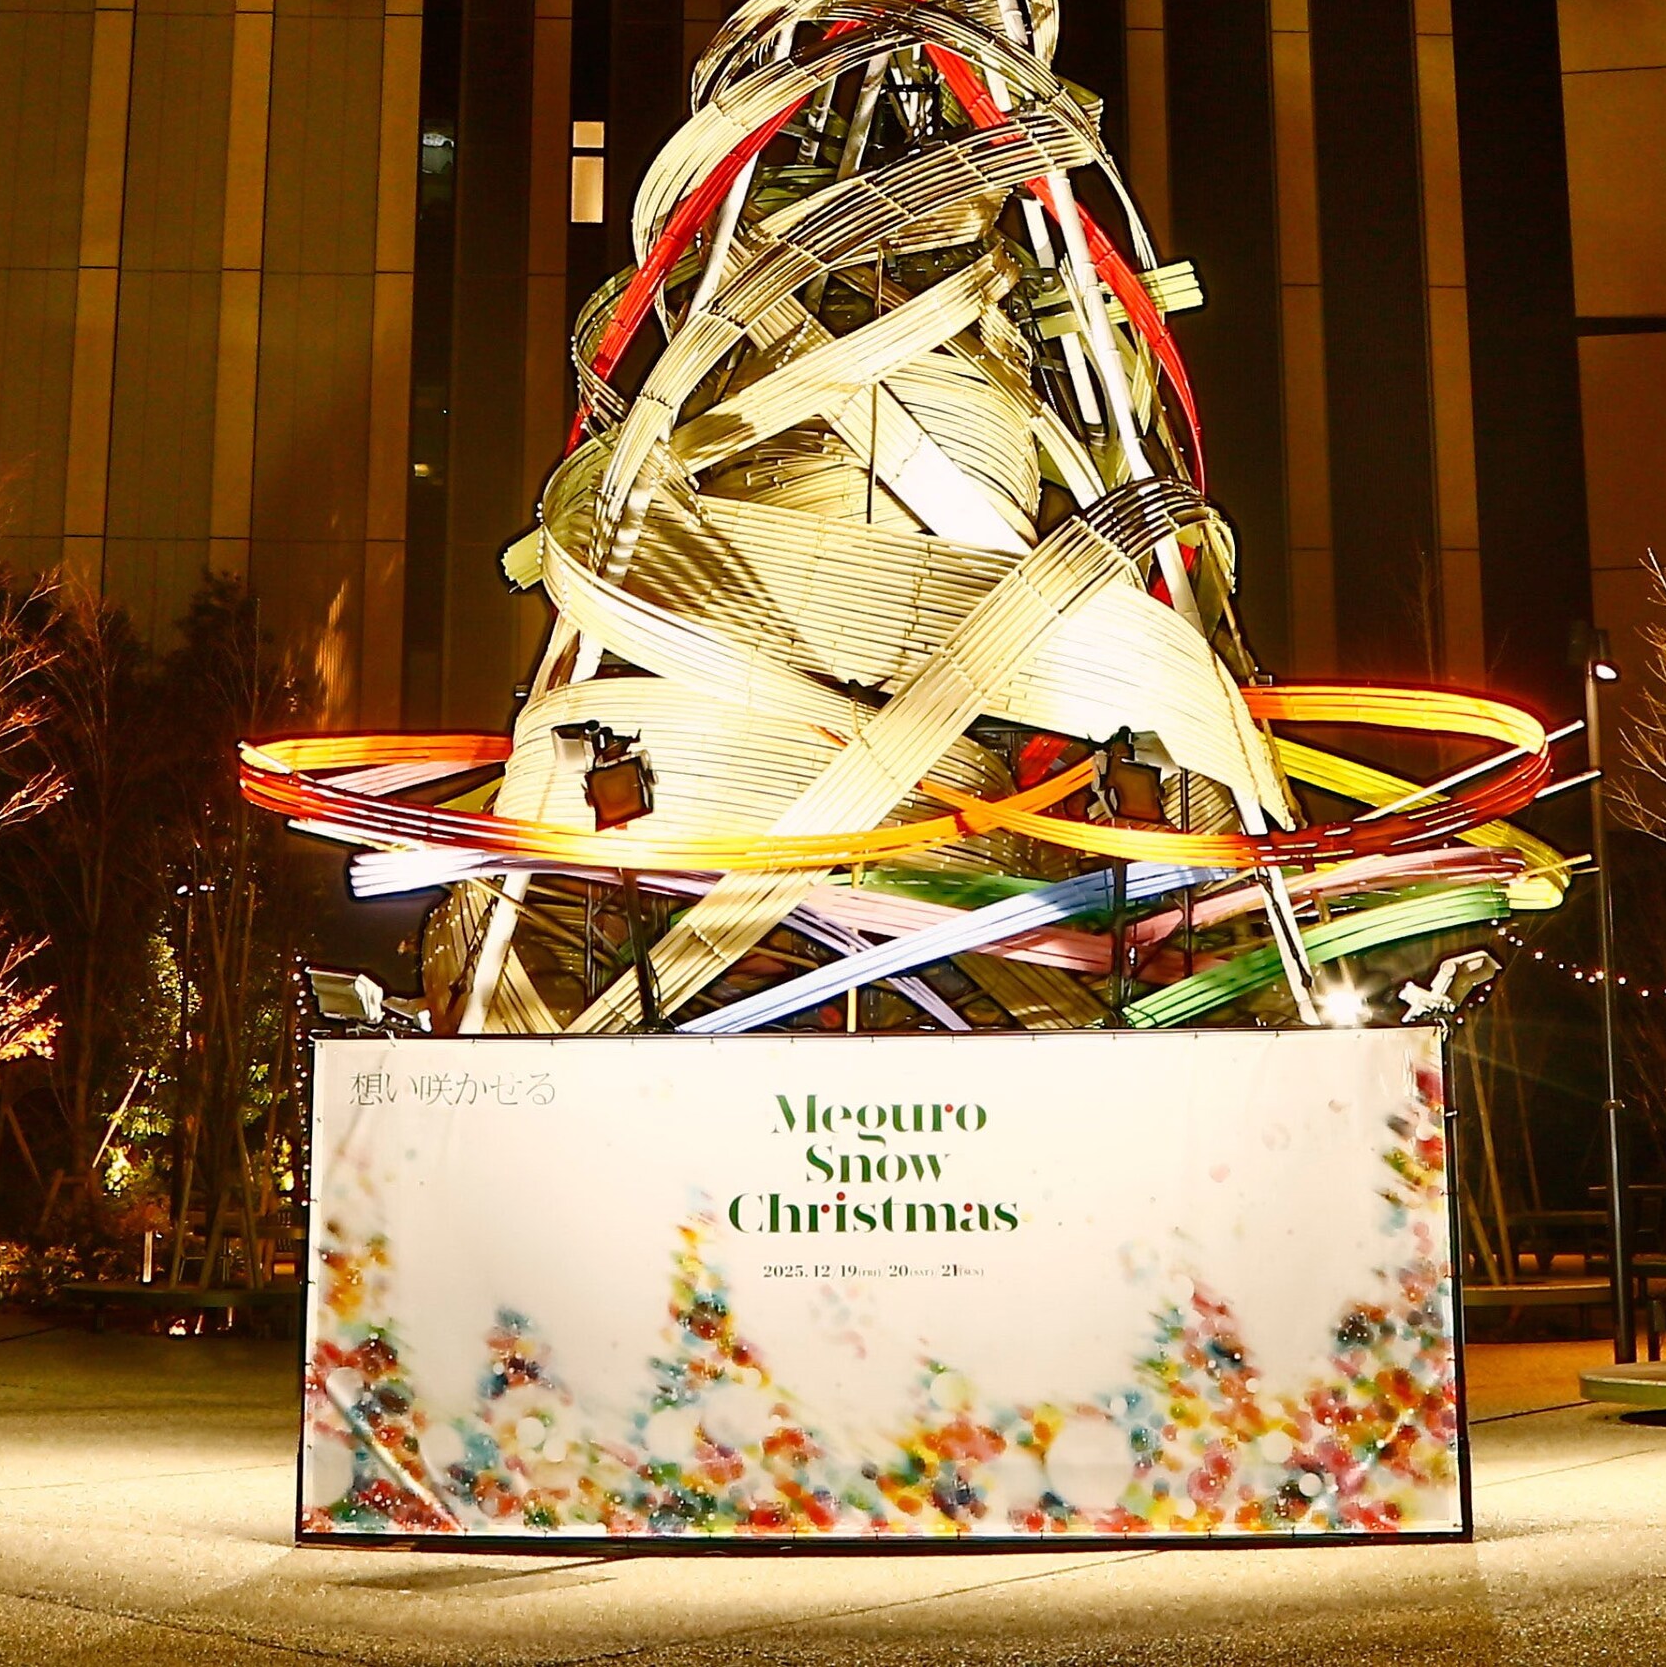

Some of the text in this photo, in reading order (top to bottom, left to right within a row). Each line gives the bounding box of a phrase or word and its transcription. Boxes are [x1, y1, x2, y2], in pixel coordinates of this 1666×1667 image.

[349, 1072, 556, 1106] 想い咲かせる
[770, 1094, 988, 1148] Meguro
[805, 1143, 951, 1184] Snow
[728, 1191, 1019, 1233] Christmas
